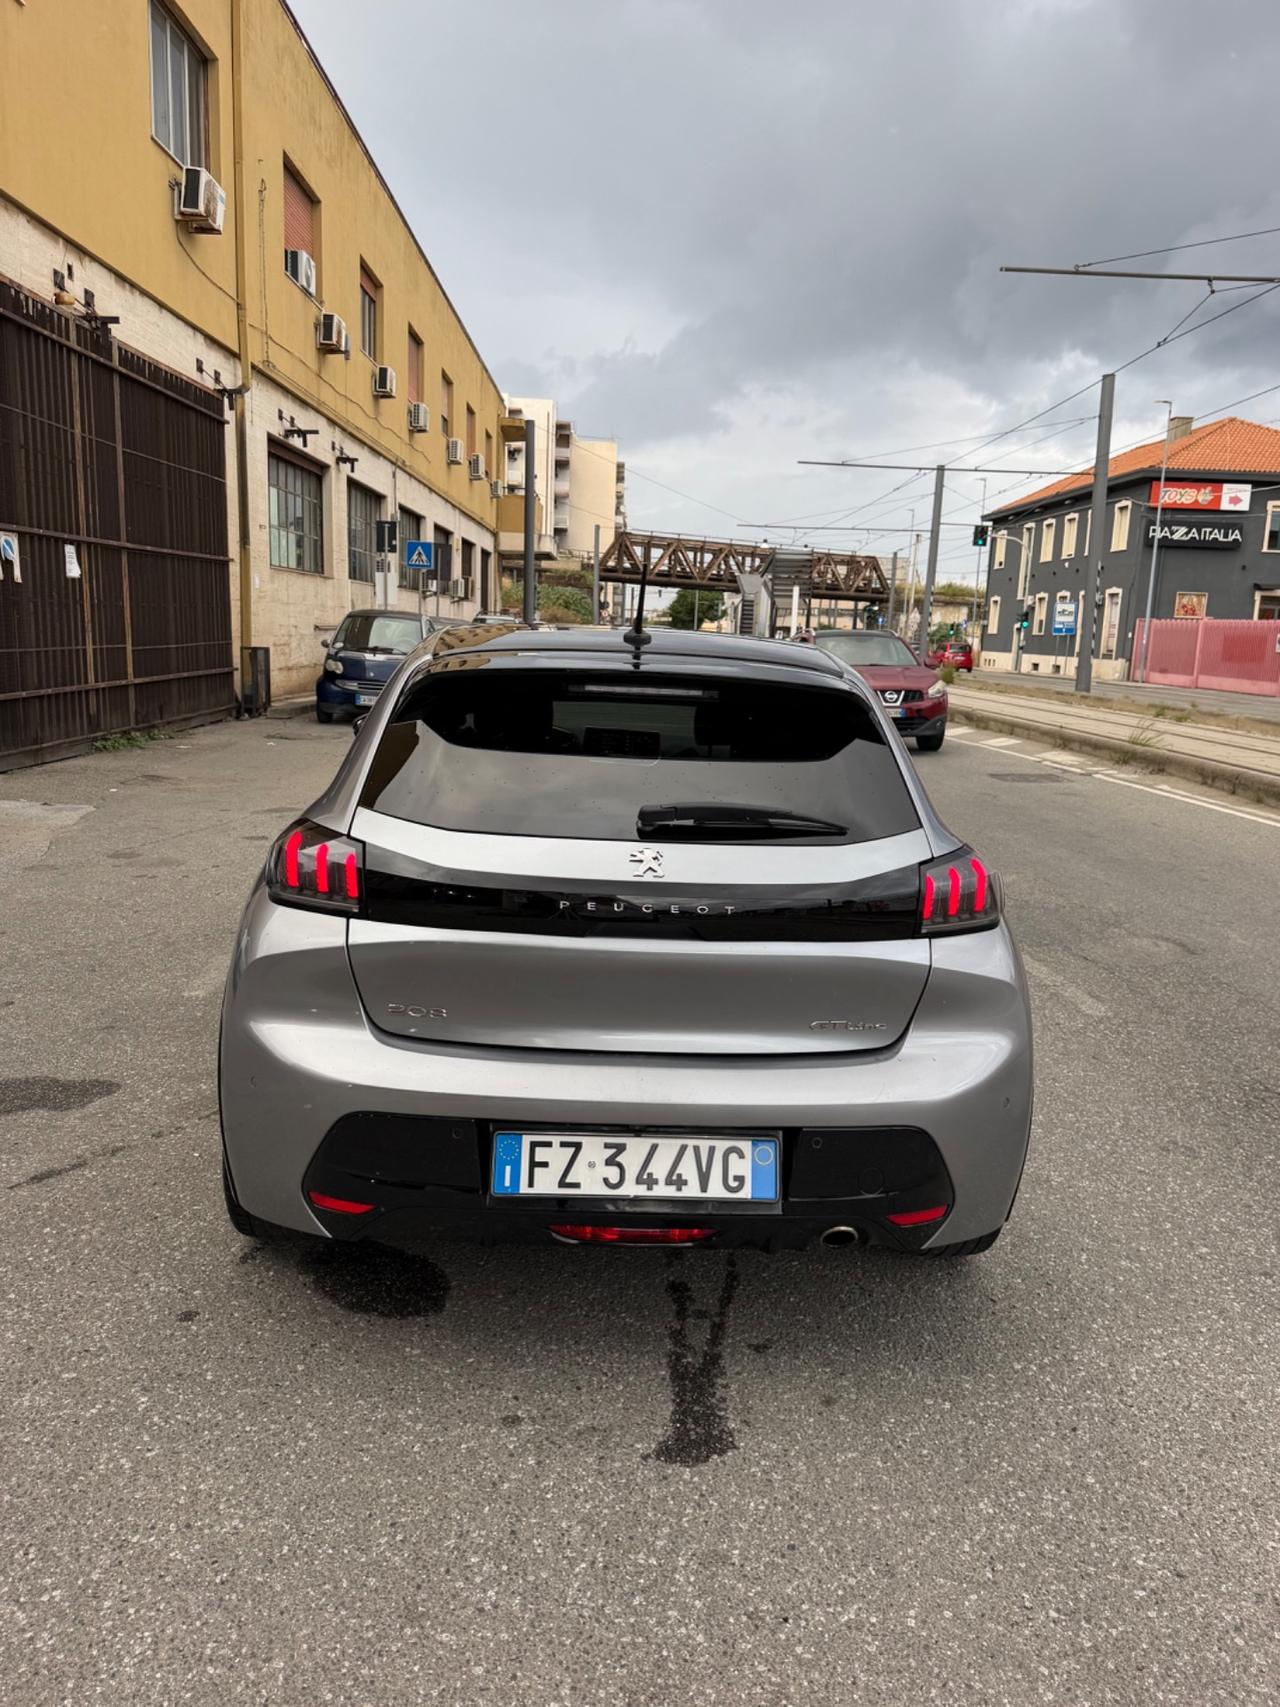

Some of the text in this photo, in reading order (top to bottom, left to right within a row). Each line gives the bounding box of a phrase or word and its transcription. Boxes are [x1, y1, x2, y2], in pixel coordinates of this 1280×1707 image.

[1160, 488, 1197, 504] TOYS
[1149, 526, 1242, 542] PIAZZA ITALIA
[559, 900, 735, 915] PEUGEOT
[388, 1003, 448, 1019] 208
